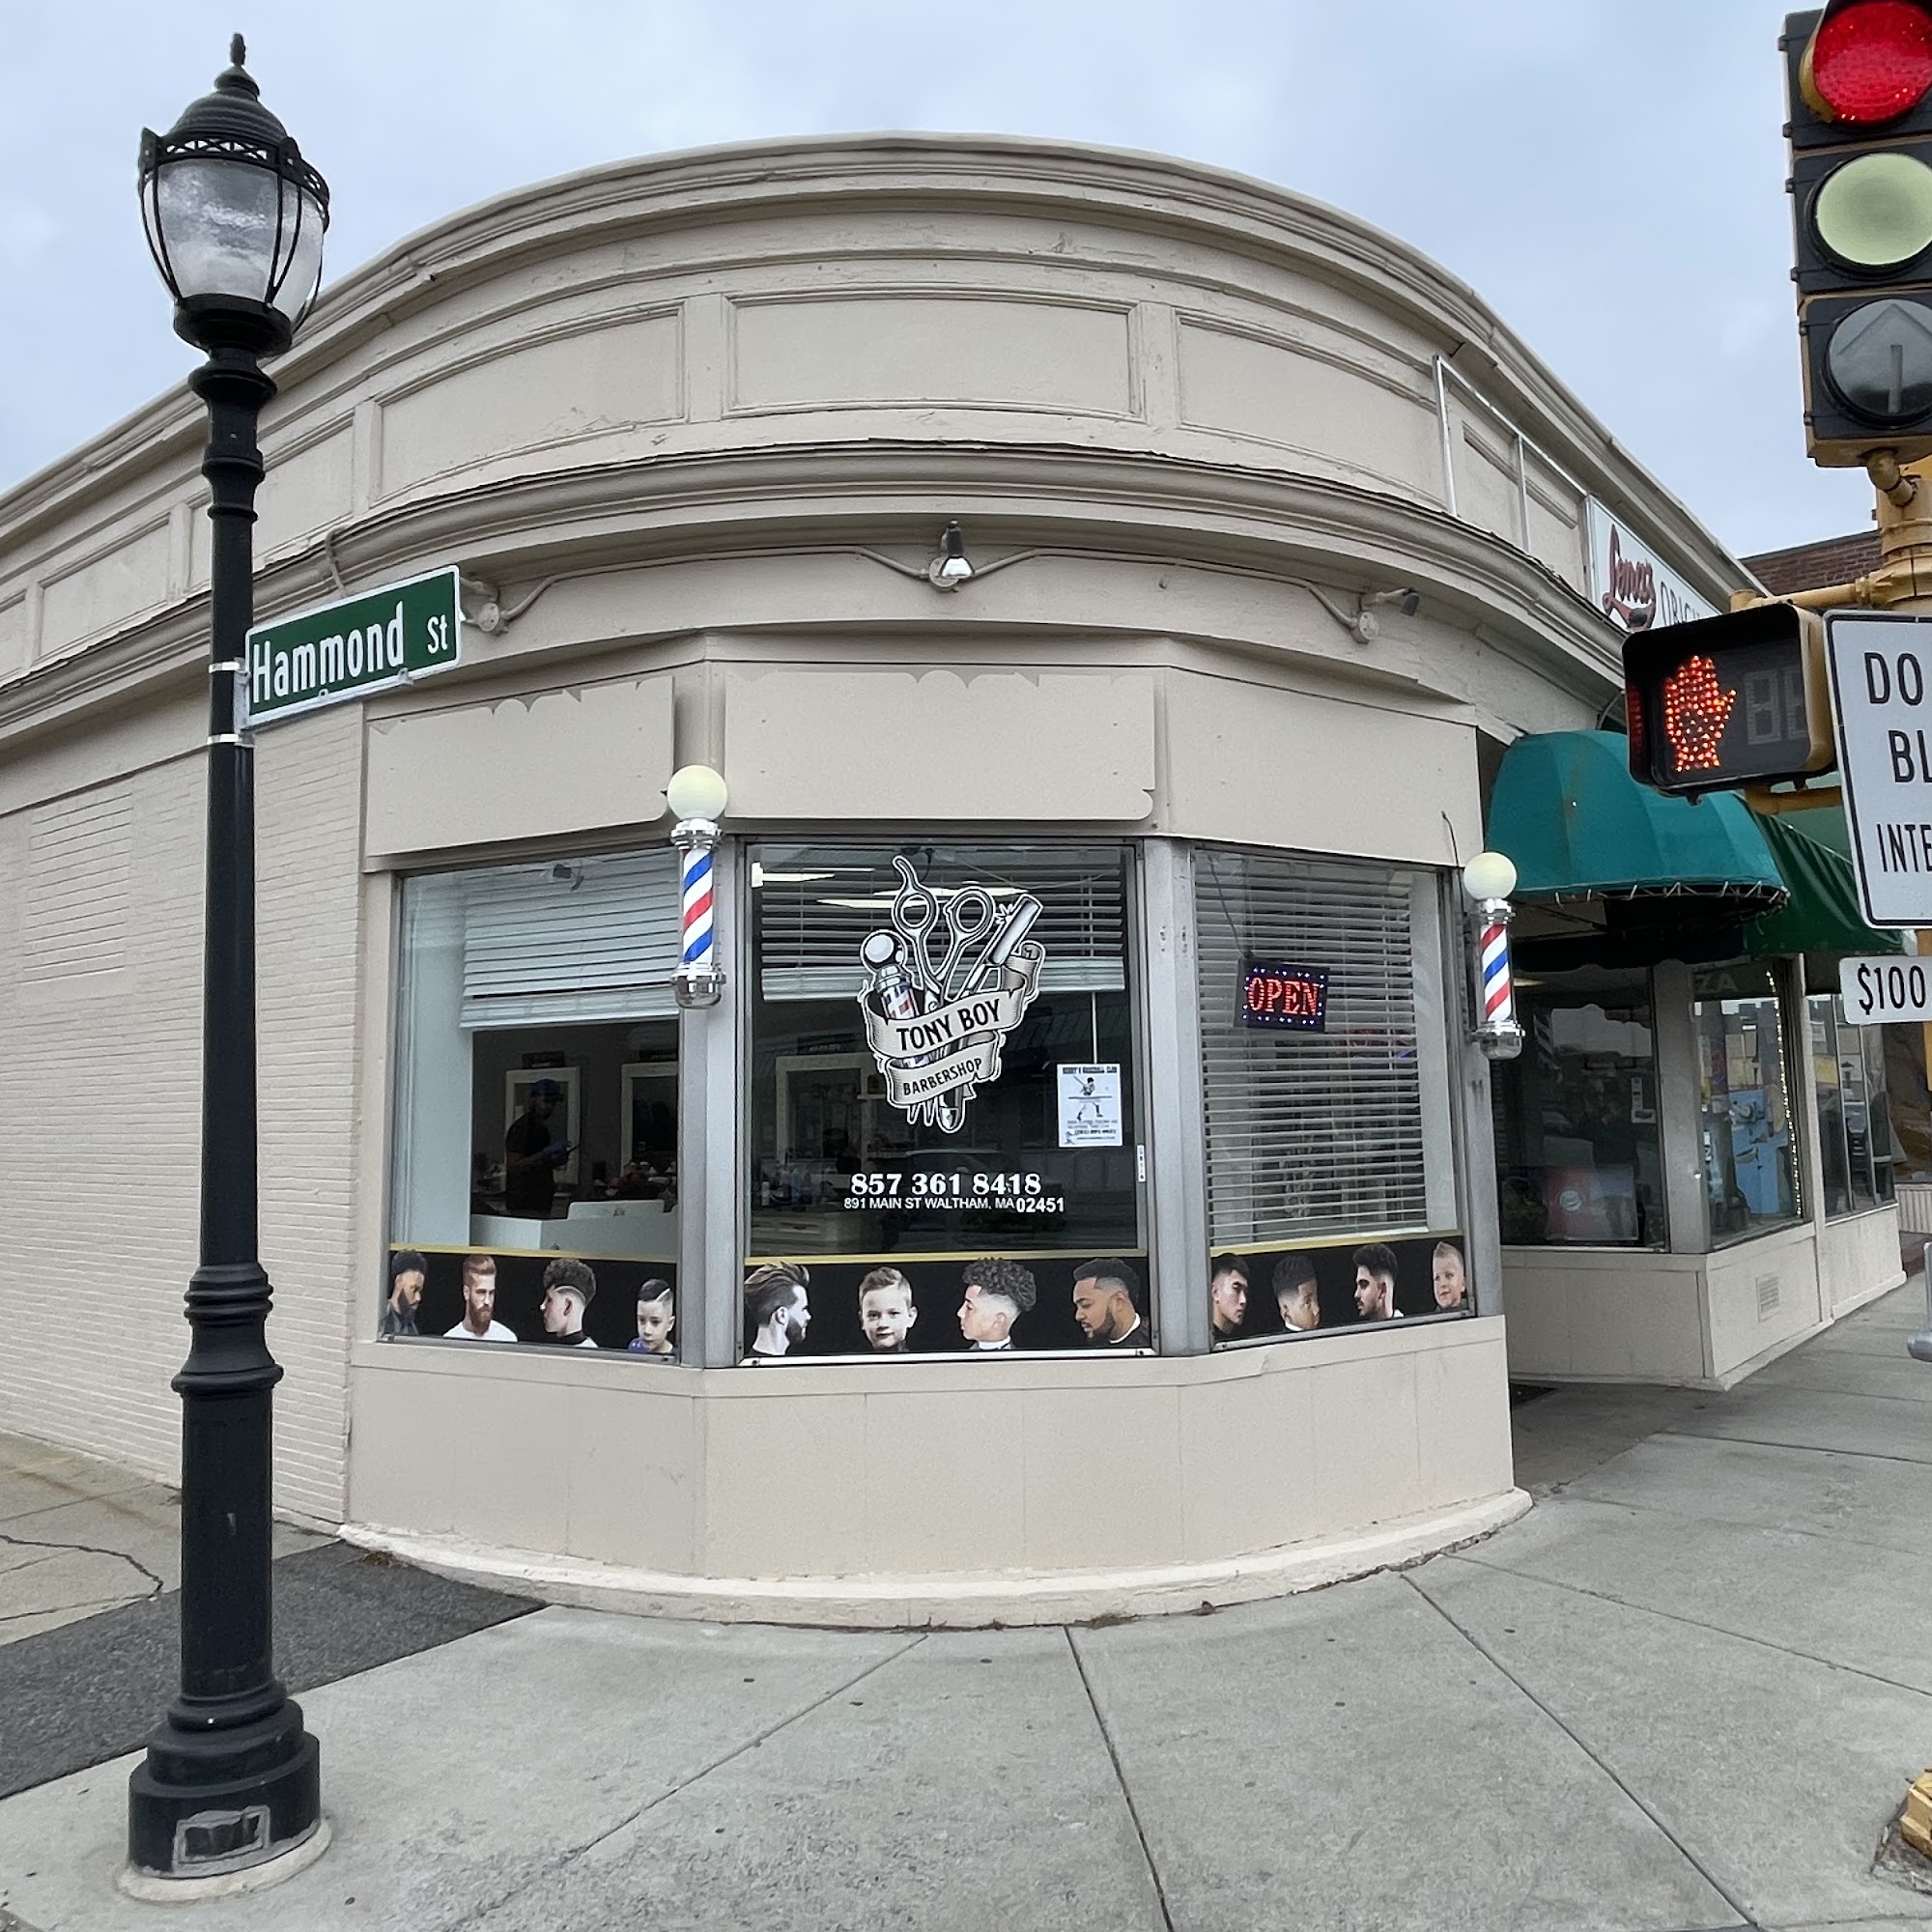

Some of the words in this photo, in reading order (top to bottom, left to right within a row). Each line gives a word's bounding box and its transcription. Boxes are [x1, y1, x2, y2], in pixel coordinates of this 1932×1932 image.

[253, 600, 404, 703] Hammond
[427, 614, 448, 654] St
[1863, 652, 1924, 706] DO
[1247, 977, 1320, 1016] OPEN
[1858, 962, 1926, 1015] $100
[895, 1014, 952, 1051] TONY
[957, 998, 1001, 1031] BOY
[902, 1058, 982, 1095] BARBERSHOP
[843, 1198, 867, 1209] 891
[869, 1198, 902, 1208] MAIN
[904, 1198, 923, 1208] ST
[995, 1198, 1015, 1208] MA
[1016, 1197, 1065, 1213] 02451
[850, 1173, 902, 1195] 857
[911, 1173, 961, 1195] 361
[972, 1173, 1041, 1195] 8418
